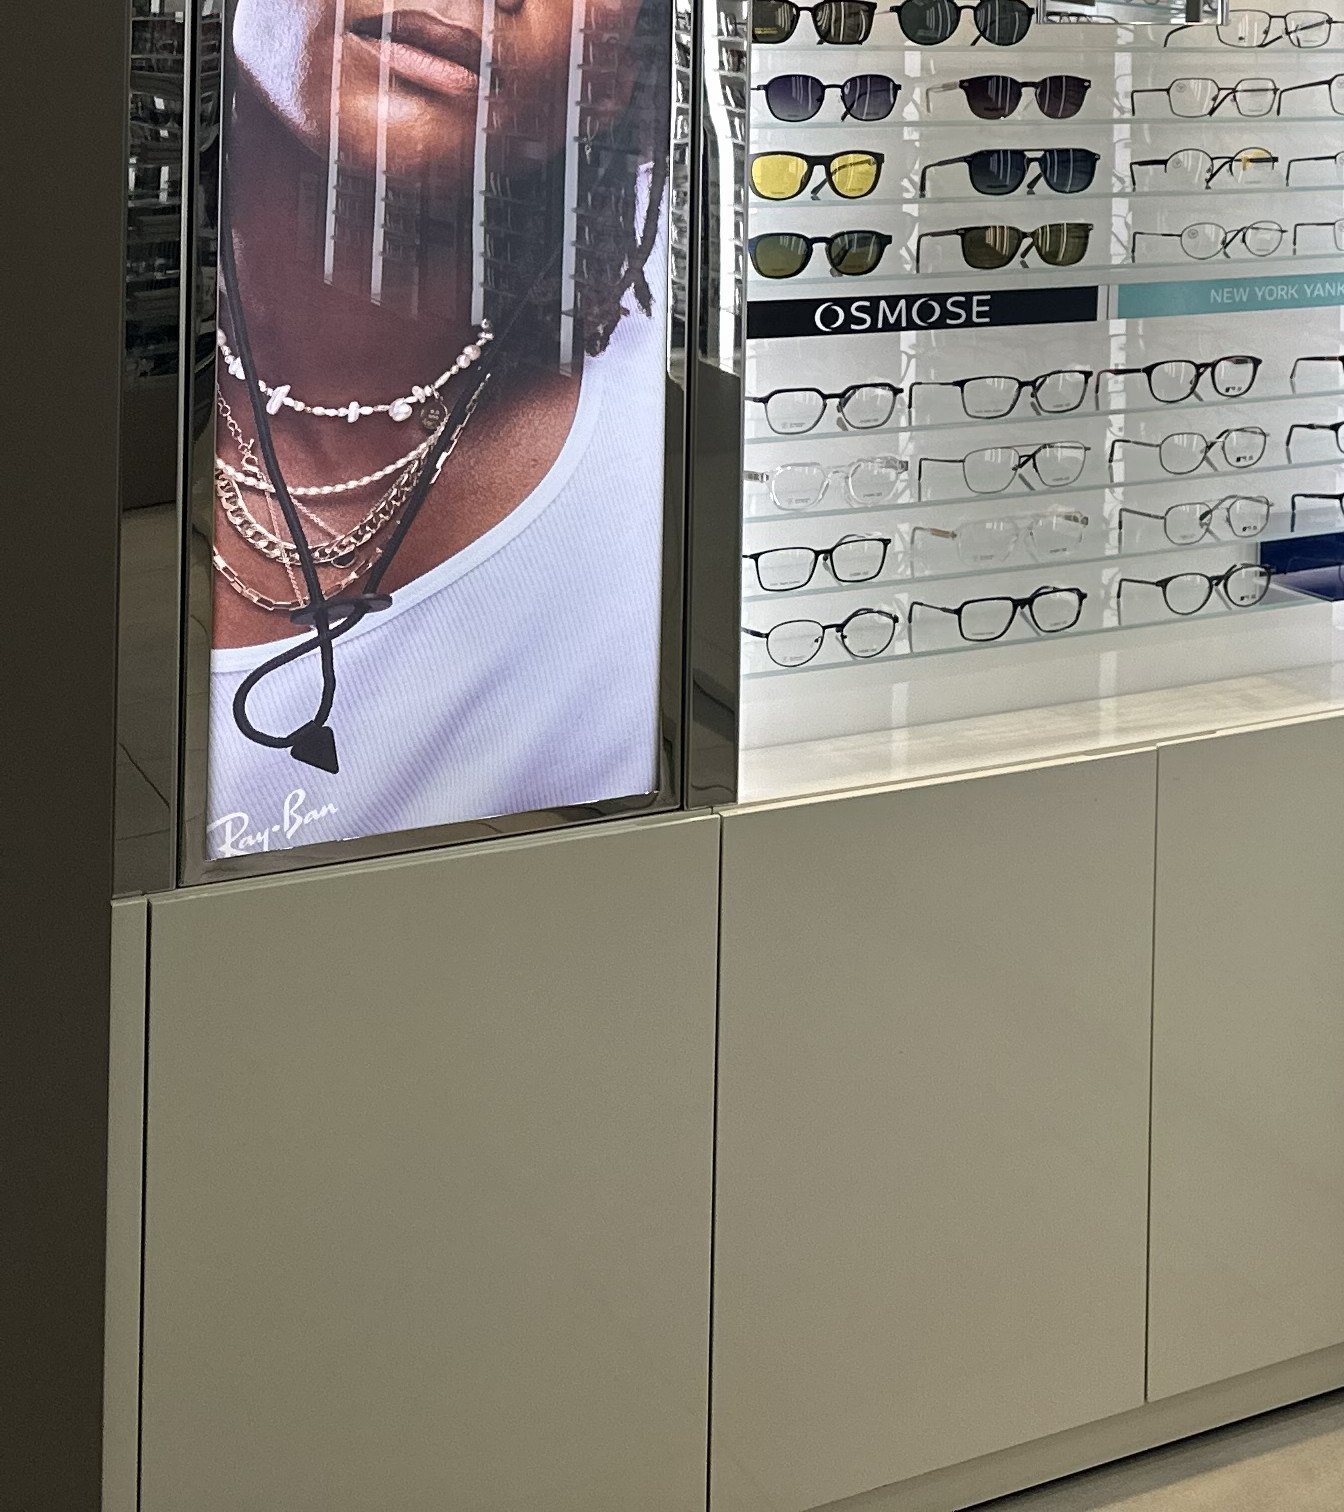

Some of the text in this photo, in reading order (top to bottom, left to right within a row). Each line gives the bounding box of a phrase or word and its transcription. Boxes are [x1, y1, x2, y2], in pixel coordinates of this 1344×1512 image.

[1210, 288, 1250, 304] NEW
[1254, 284, 1299, 300] YORK
[814, 295, 992, 332] OSMOSE
[206, 788, 338, 858] Ray-Ban
